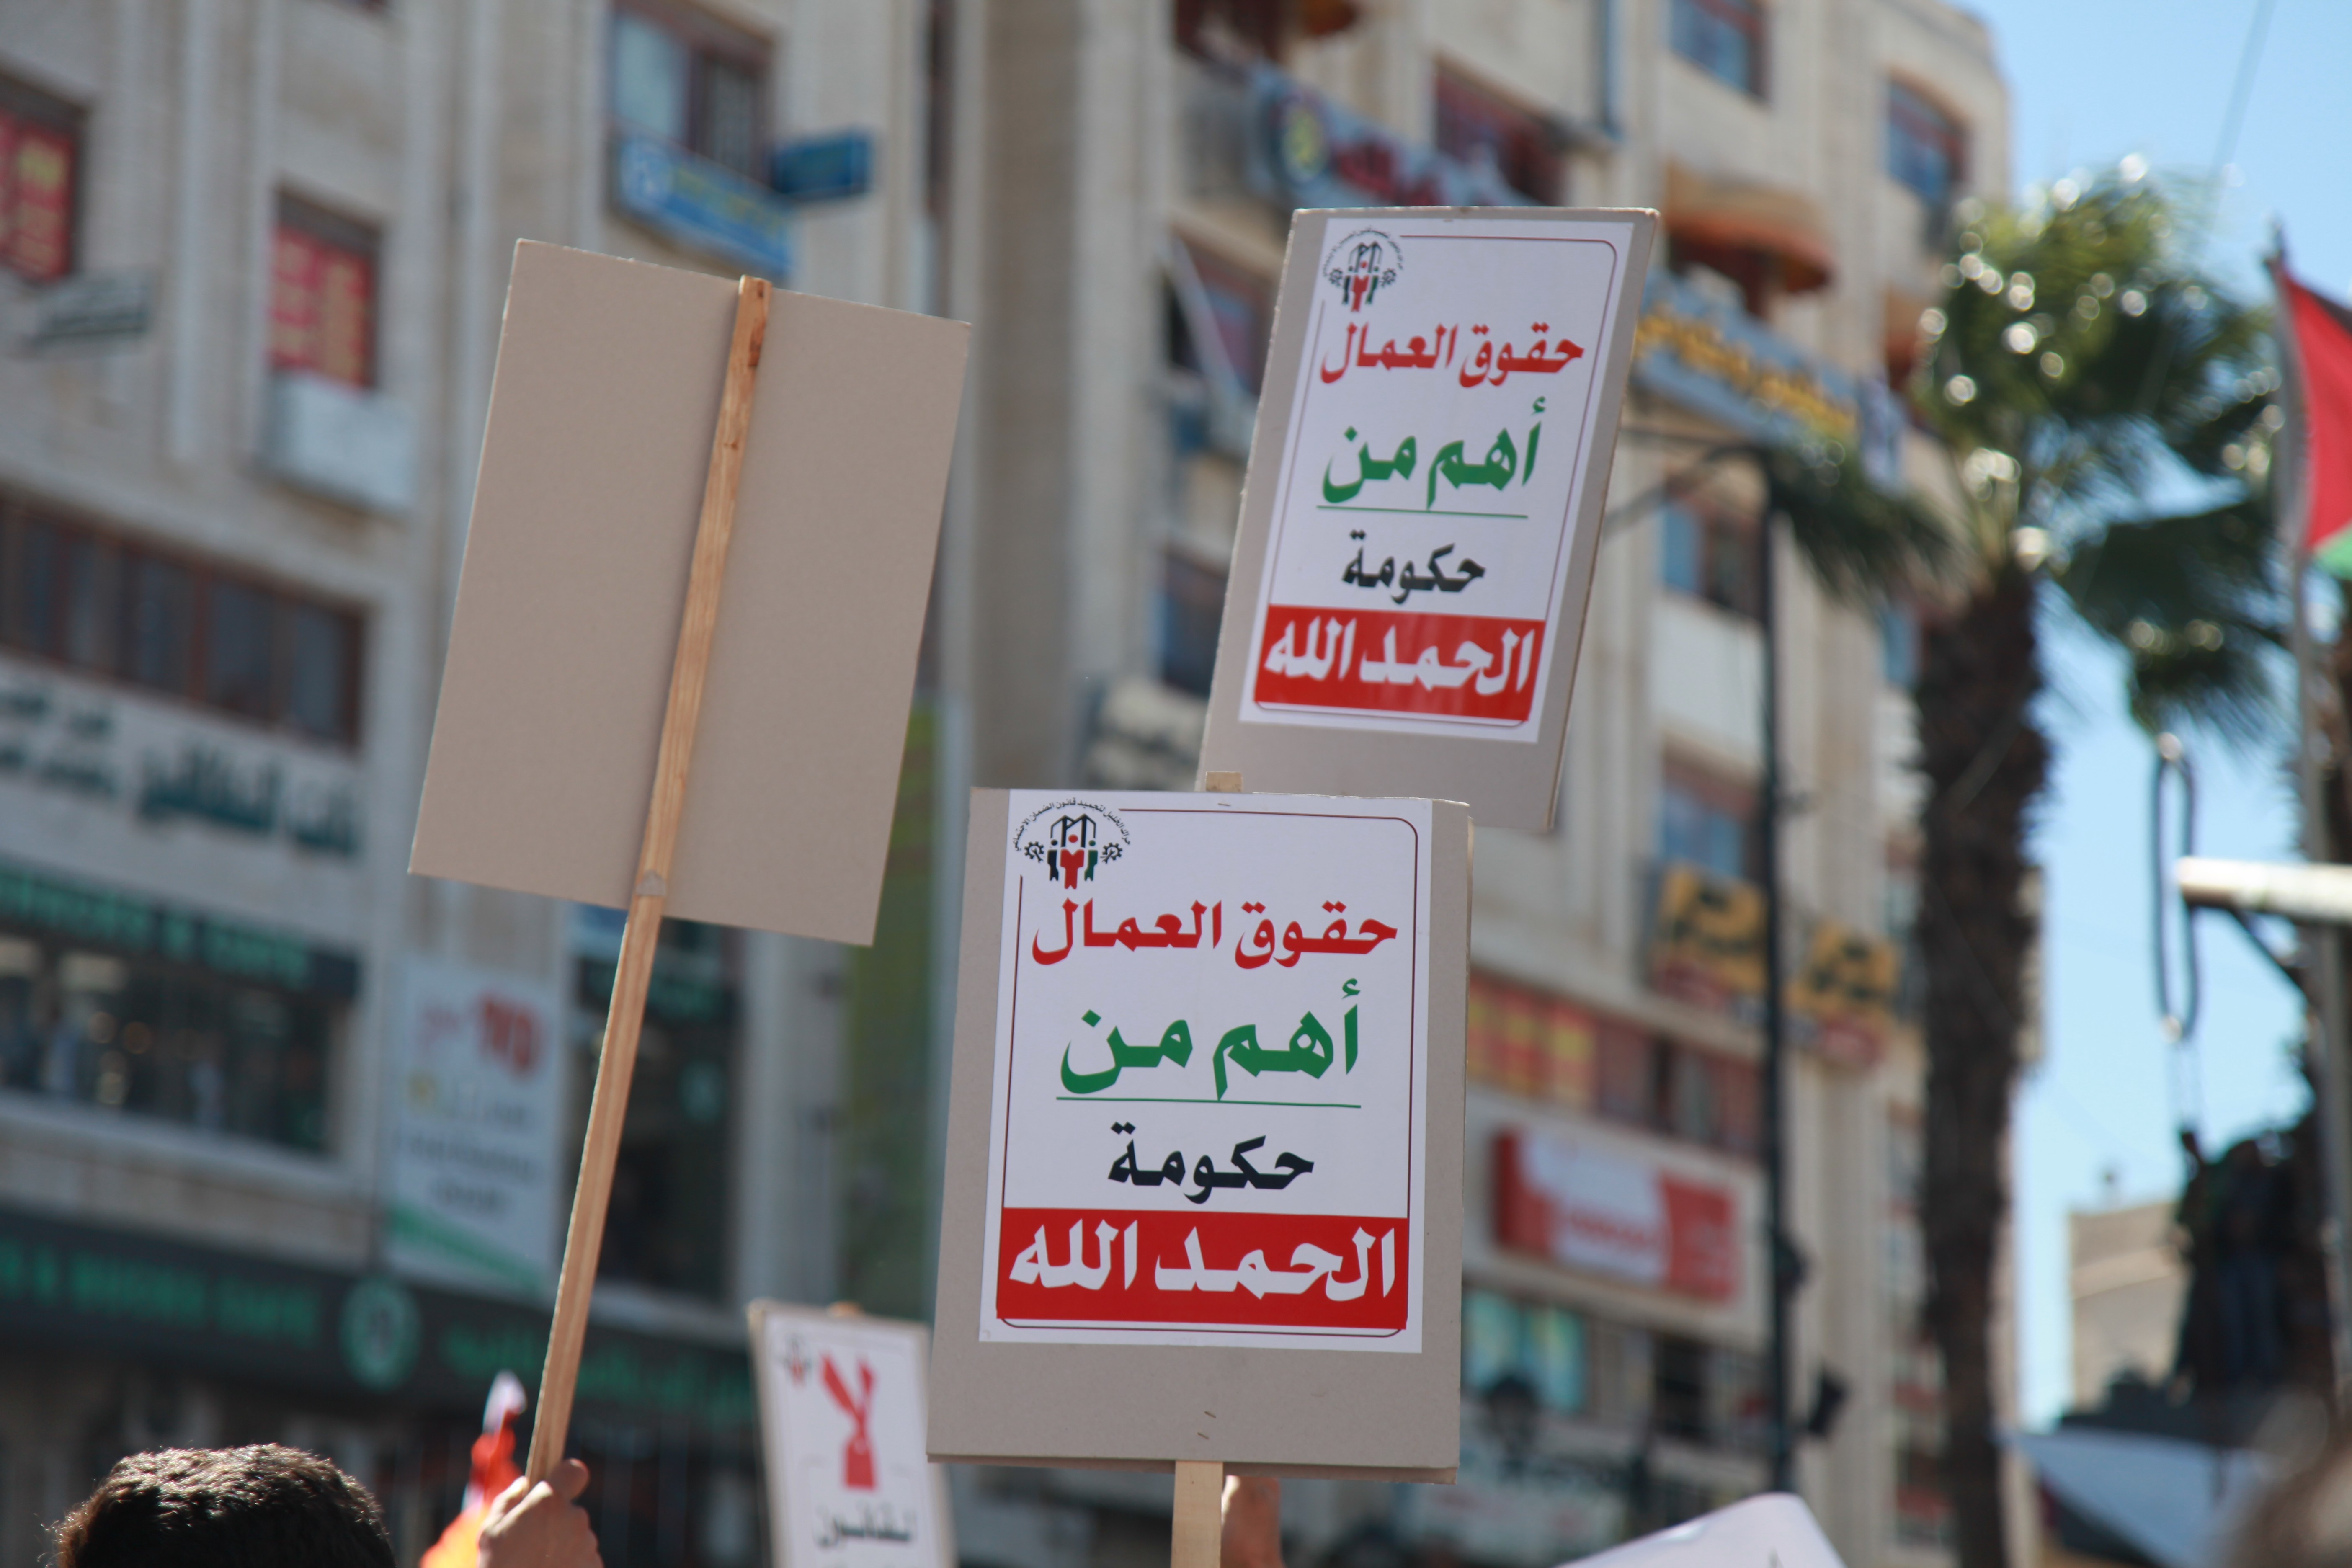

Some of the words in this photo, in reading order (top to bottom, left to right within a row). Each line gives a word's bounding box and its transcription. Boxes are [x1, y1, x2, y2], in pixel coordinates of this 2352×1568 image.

[1320, 323, 1459, 384] العمال
[1459, 322, 1585, 388] حقوق
[1323, 426, 1416, 504] من
[1427, 397, 1545, 509] أهم
[1342, 529, 1486, 606] حكومة
[1264, 615, 1357, 681] الله
[1359, 627, 1534, 696] الحمد
[1013, 818, 1030, 851] الاجتماعي
[1029, 802, 1055, 822] الضمان
[1056, 797, 1076, 809] قانون
[1077, 800, 1105, 812] لتجميد
[1103, 811, 1124, 828] الخليل
[1120, 828, 1130, 845] حراك
[1032, 898, 1222, 965] العمال
[1235, 900, 1398, 970] حقوق
[1061, 1009, 1194, 1094] من
[1213, 978, 1361, 1099] أهم
[1107, 1122, 1315, 1204] حكومة
[1009, 1218, 1138, 1290] الله
[1155, 1226, 1395, 1302] الحمد
